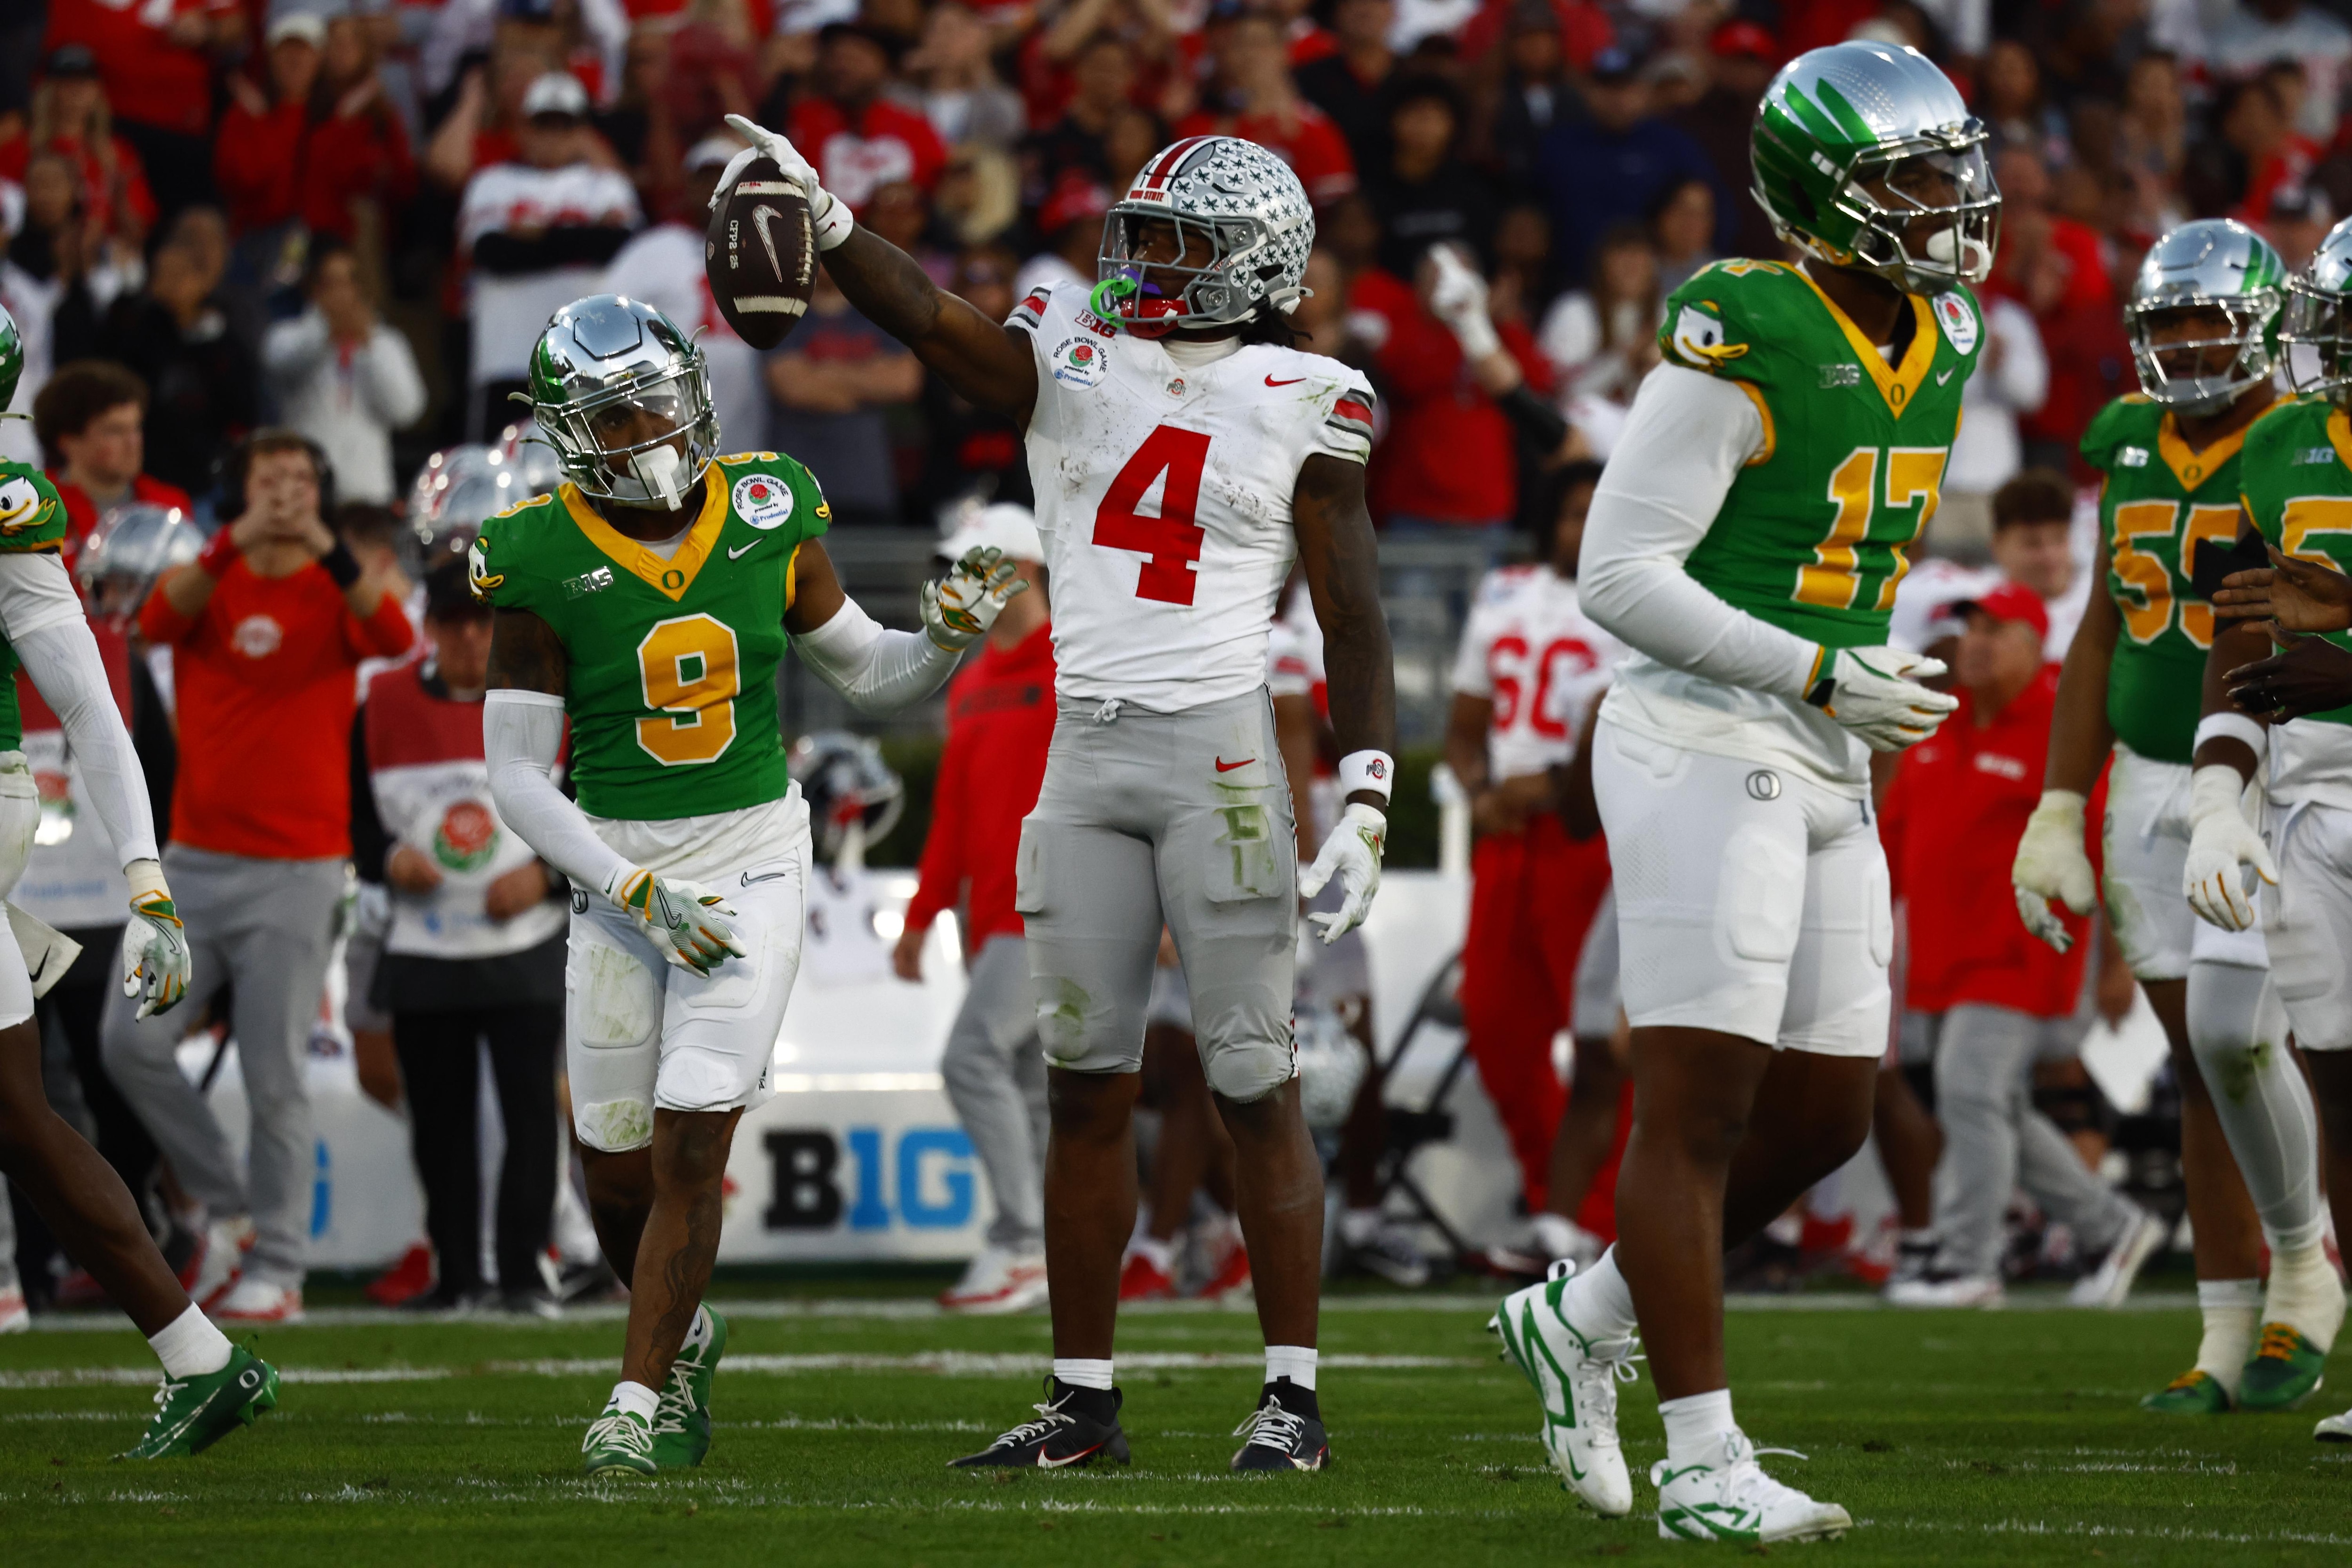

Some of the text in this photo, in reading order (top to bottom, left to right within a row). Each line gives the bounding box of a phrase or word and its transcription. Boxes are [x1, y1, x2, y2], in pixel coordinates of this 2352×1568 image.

[1053, 336, 1108, 373] ROSE BOWL GAME
[1064, 374, 1093, 386] Prudential
[735, 477, 789, 510] ROSE BOWL GAME
[760, 509, 788, 522] Prudential
[1091, 424, 1212, 606] 4
[1789, 446, 1949, 611] 17
[635, 612, 741, 767] 9
